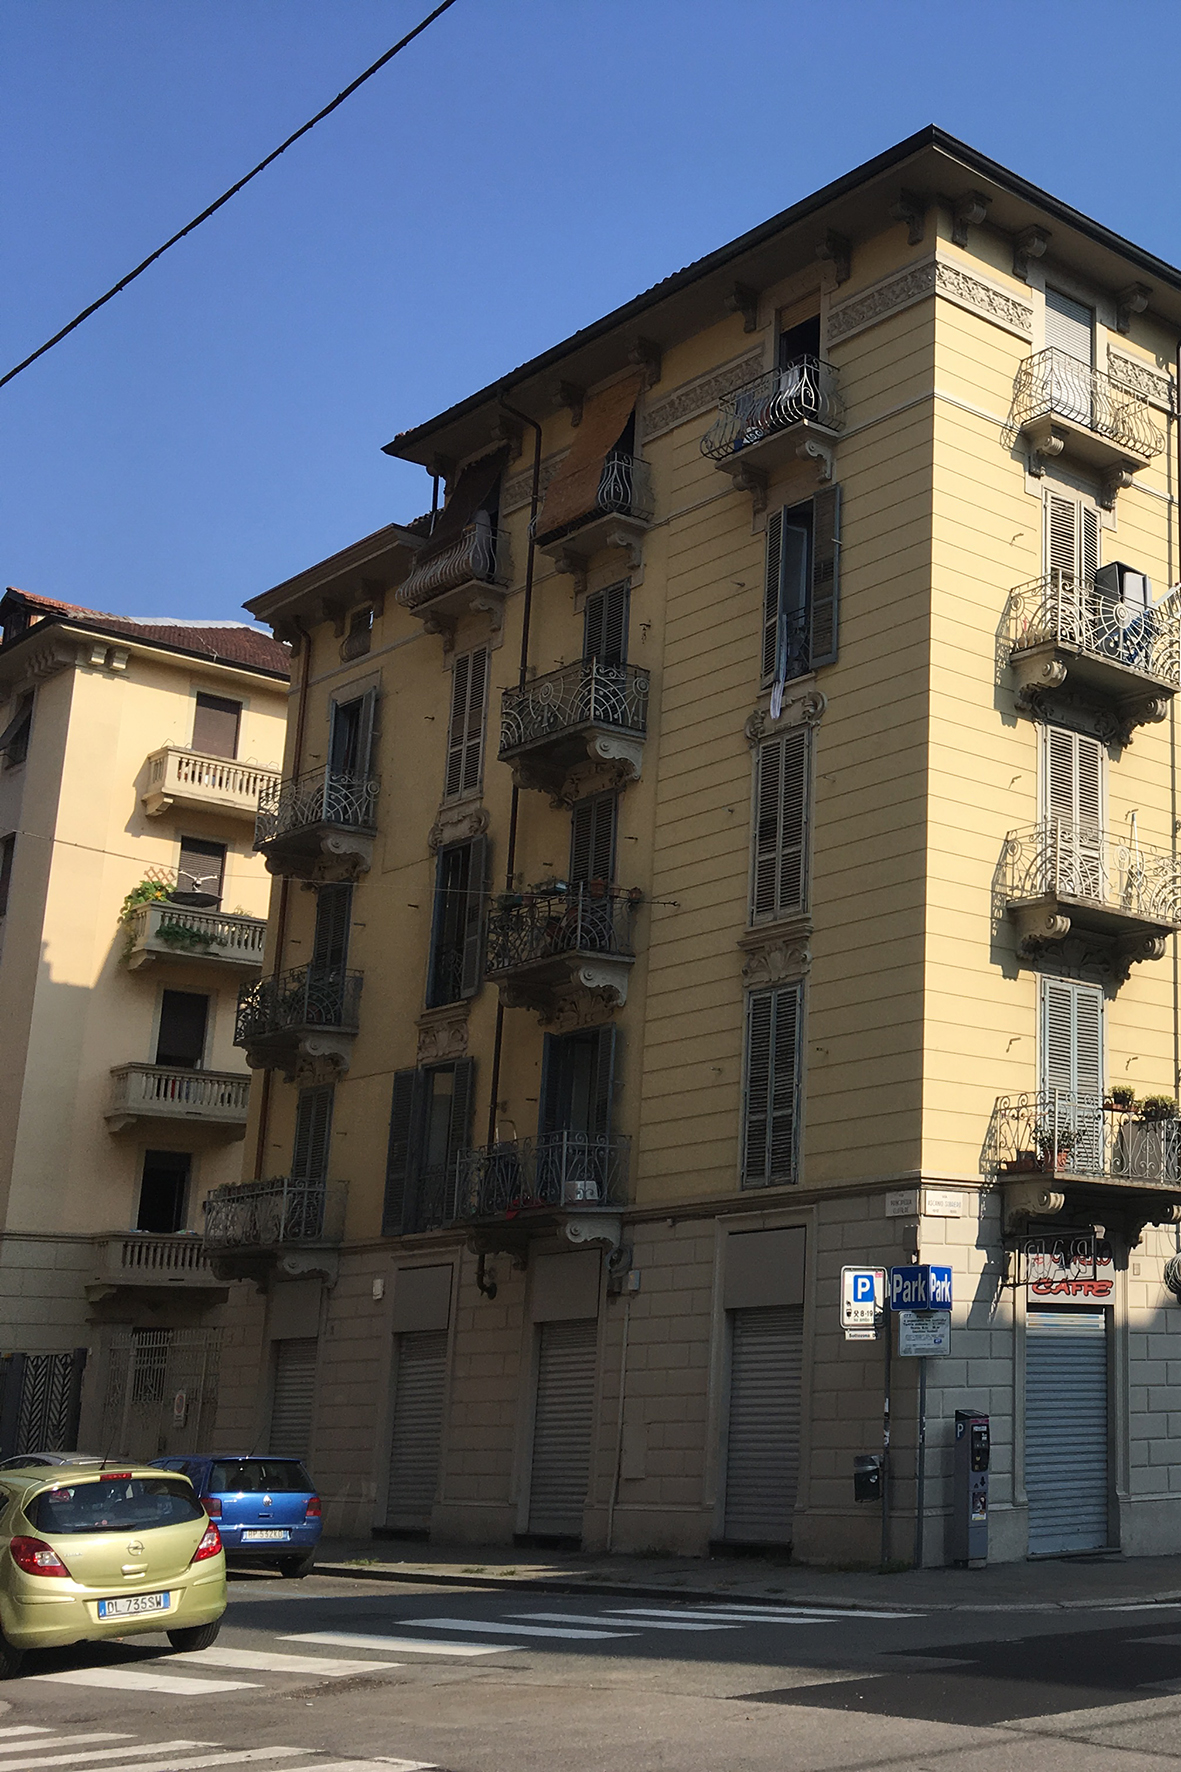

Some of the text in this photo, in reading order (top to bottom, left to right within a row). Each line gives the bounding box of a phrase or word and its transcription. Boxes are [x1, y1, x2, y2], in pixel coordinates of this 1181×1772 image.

[857, 1277, 871, 1300] P
[892, 1273, 926, 1303] Park
[930, 1272, 951, 1303] Park
[107, 1595, 162, 1614] DL 735SW
